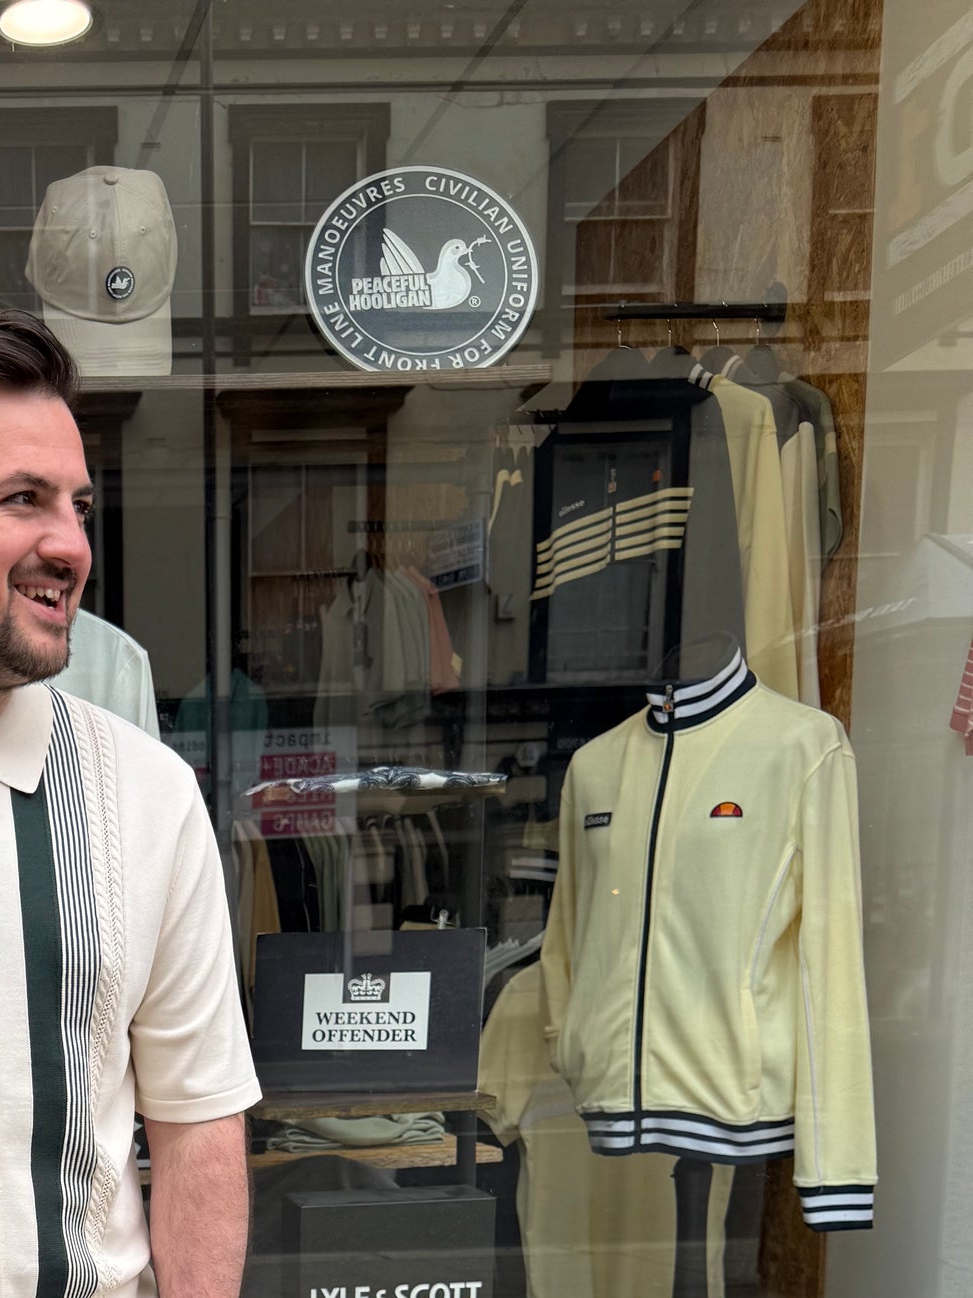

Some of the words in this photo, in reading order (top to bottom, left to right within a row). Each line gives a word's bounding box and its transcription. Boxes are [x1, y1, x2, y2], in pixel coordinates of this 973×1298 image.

[425, 176, 513, 235] CIVILIAN
[316, 177, 406, 295] MANOEUVRES
[351, 274, 429, 294] PEACEFUL
[490, 238, 529, 341] UNIFORM
[349, 291, 431, 311] HOOLIGAN
[323, 301, 364, 349] LINE
[448, 338, 494, 369] FOR
[316, 1011, 416, 1026] WEEKEND
[312, 1029, 417, 1043] OFFENDER
